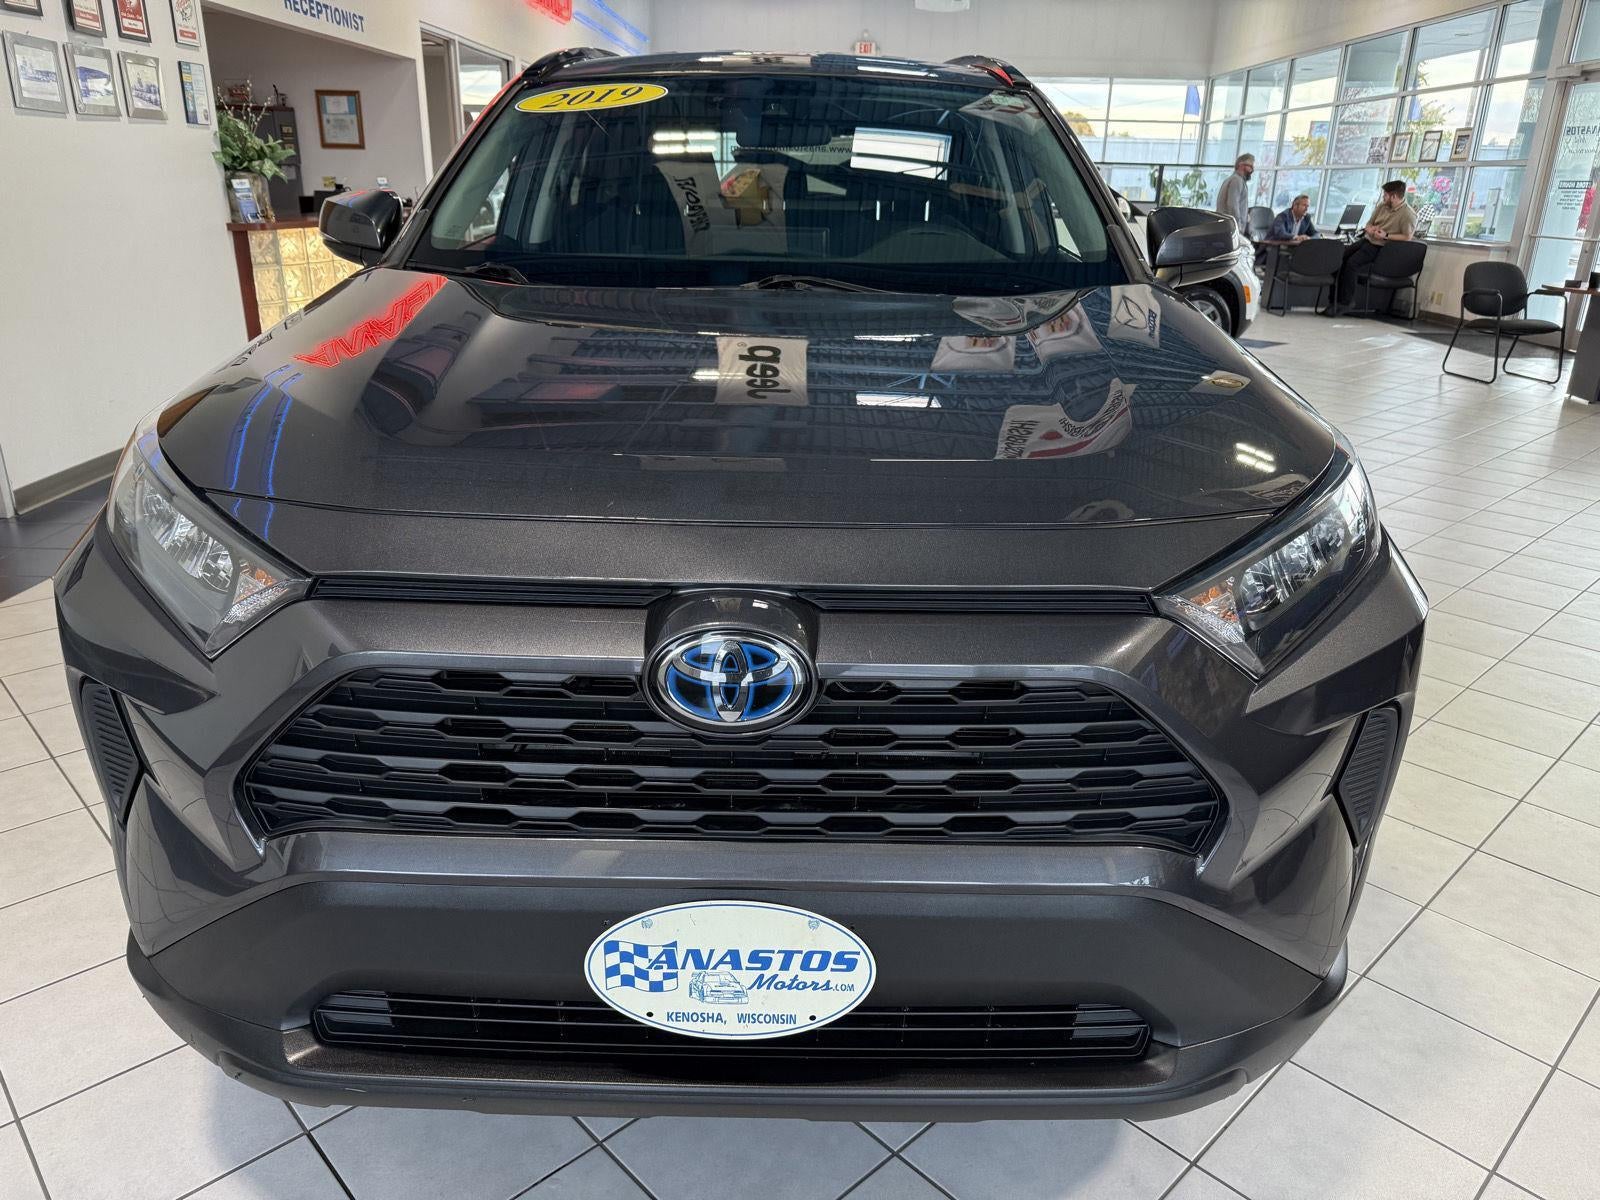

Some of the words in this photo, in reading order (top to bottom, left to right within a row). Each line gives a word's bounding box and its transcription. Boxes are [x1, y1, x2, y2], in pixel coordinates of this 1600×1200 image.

[859, 42, 873, 54] EXIT
[540, 85, 644, 109] 2019
[645, 948, 860, 973] ANASTOS
[666, 1011, 727, 1025] KENOSHA,
[737, 1013, 797, 1025] WISCONSIN
